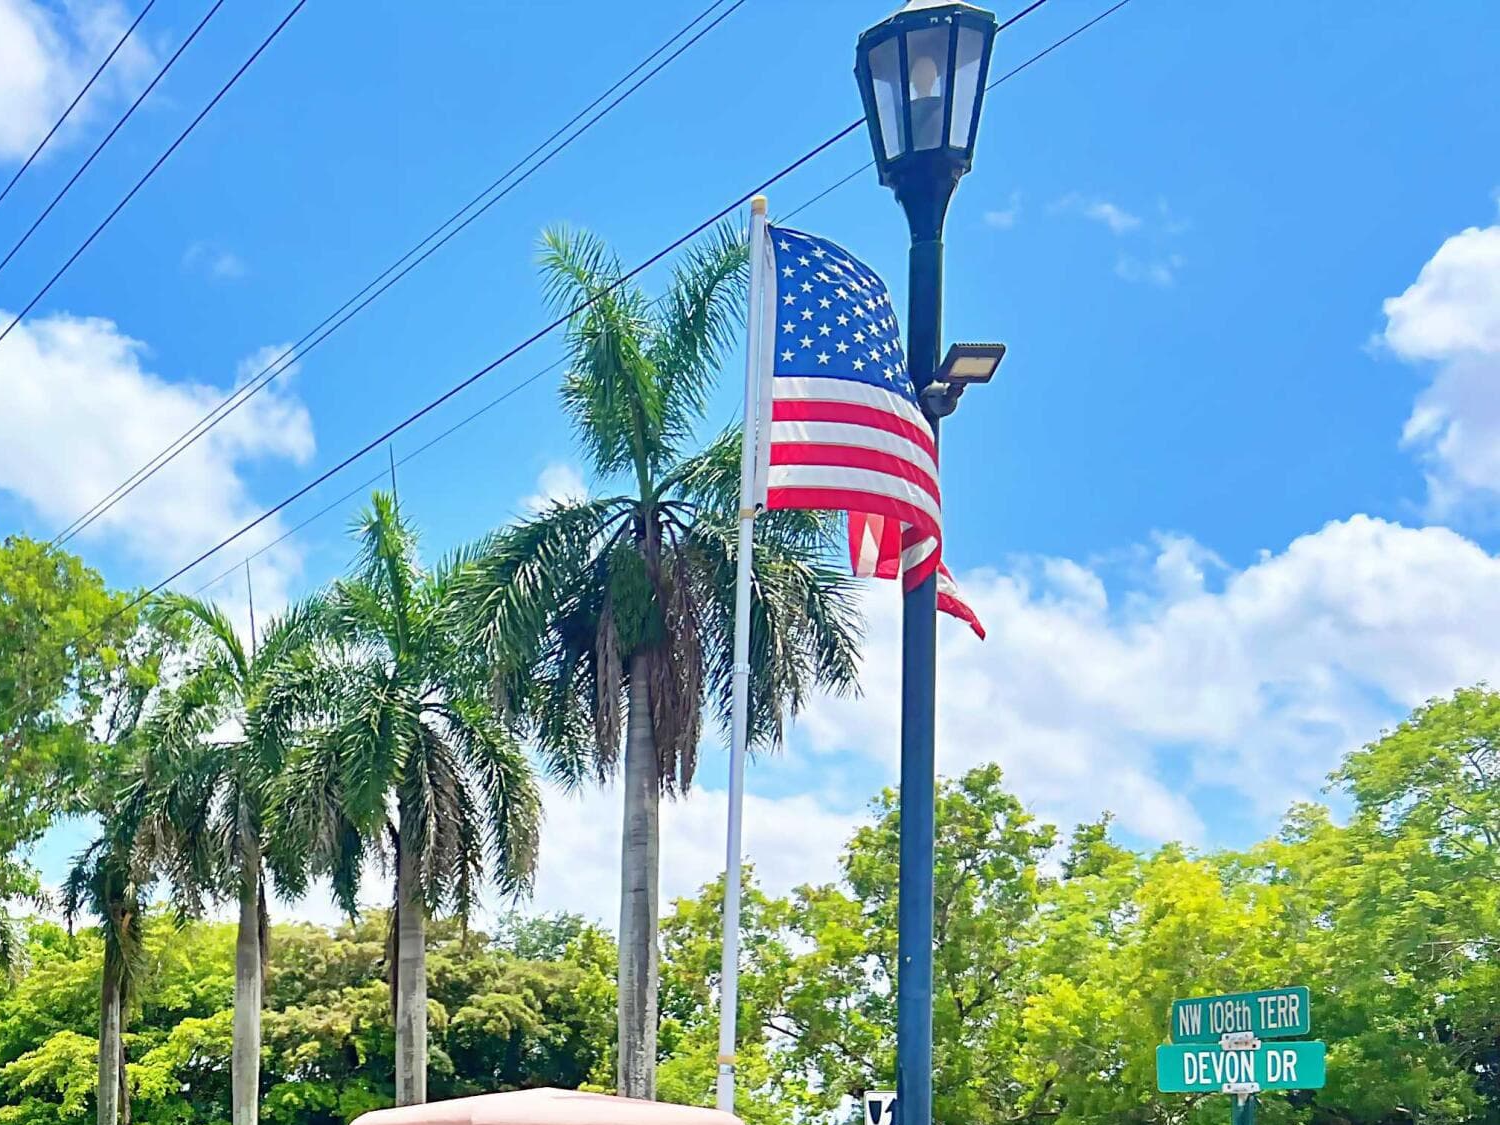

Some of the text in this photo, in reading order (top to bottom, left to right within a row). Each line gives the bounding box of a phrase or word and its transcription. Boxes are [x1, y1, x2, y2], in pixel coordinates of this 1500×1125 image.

[1179, 994, 1300, 1036] NW 108th TERR
[1184, 1050, 1298, 1084] DEVON DR
